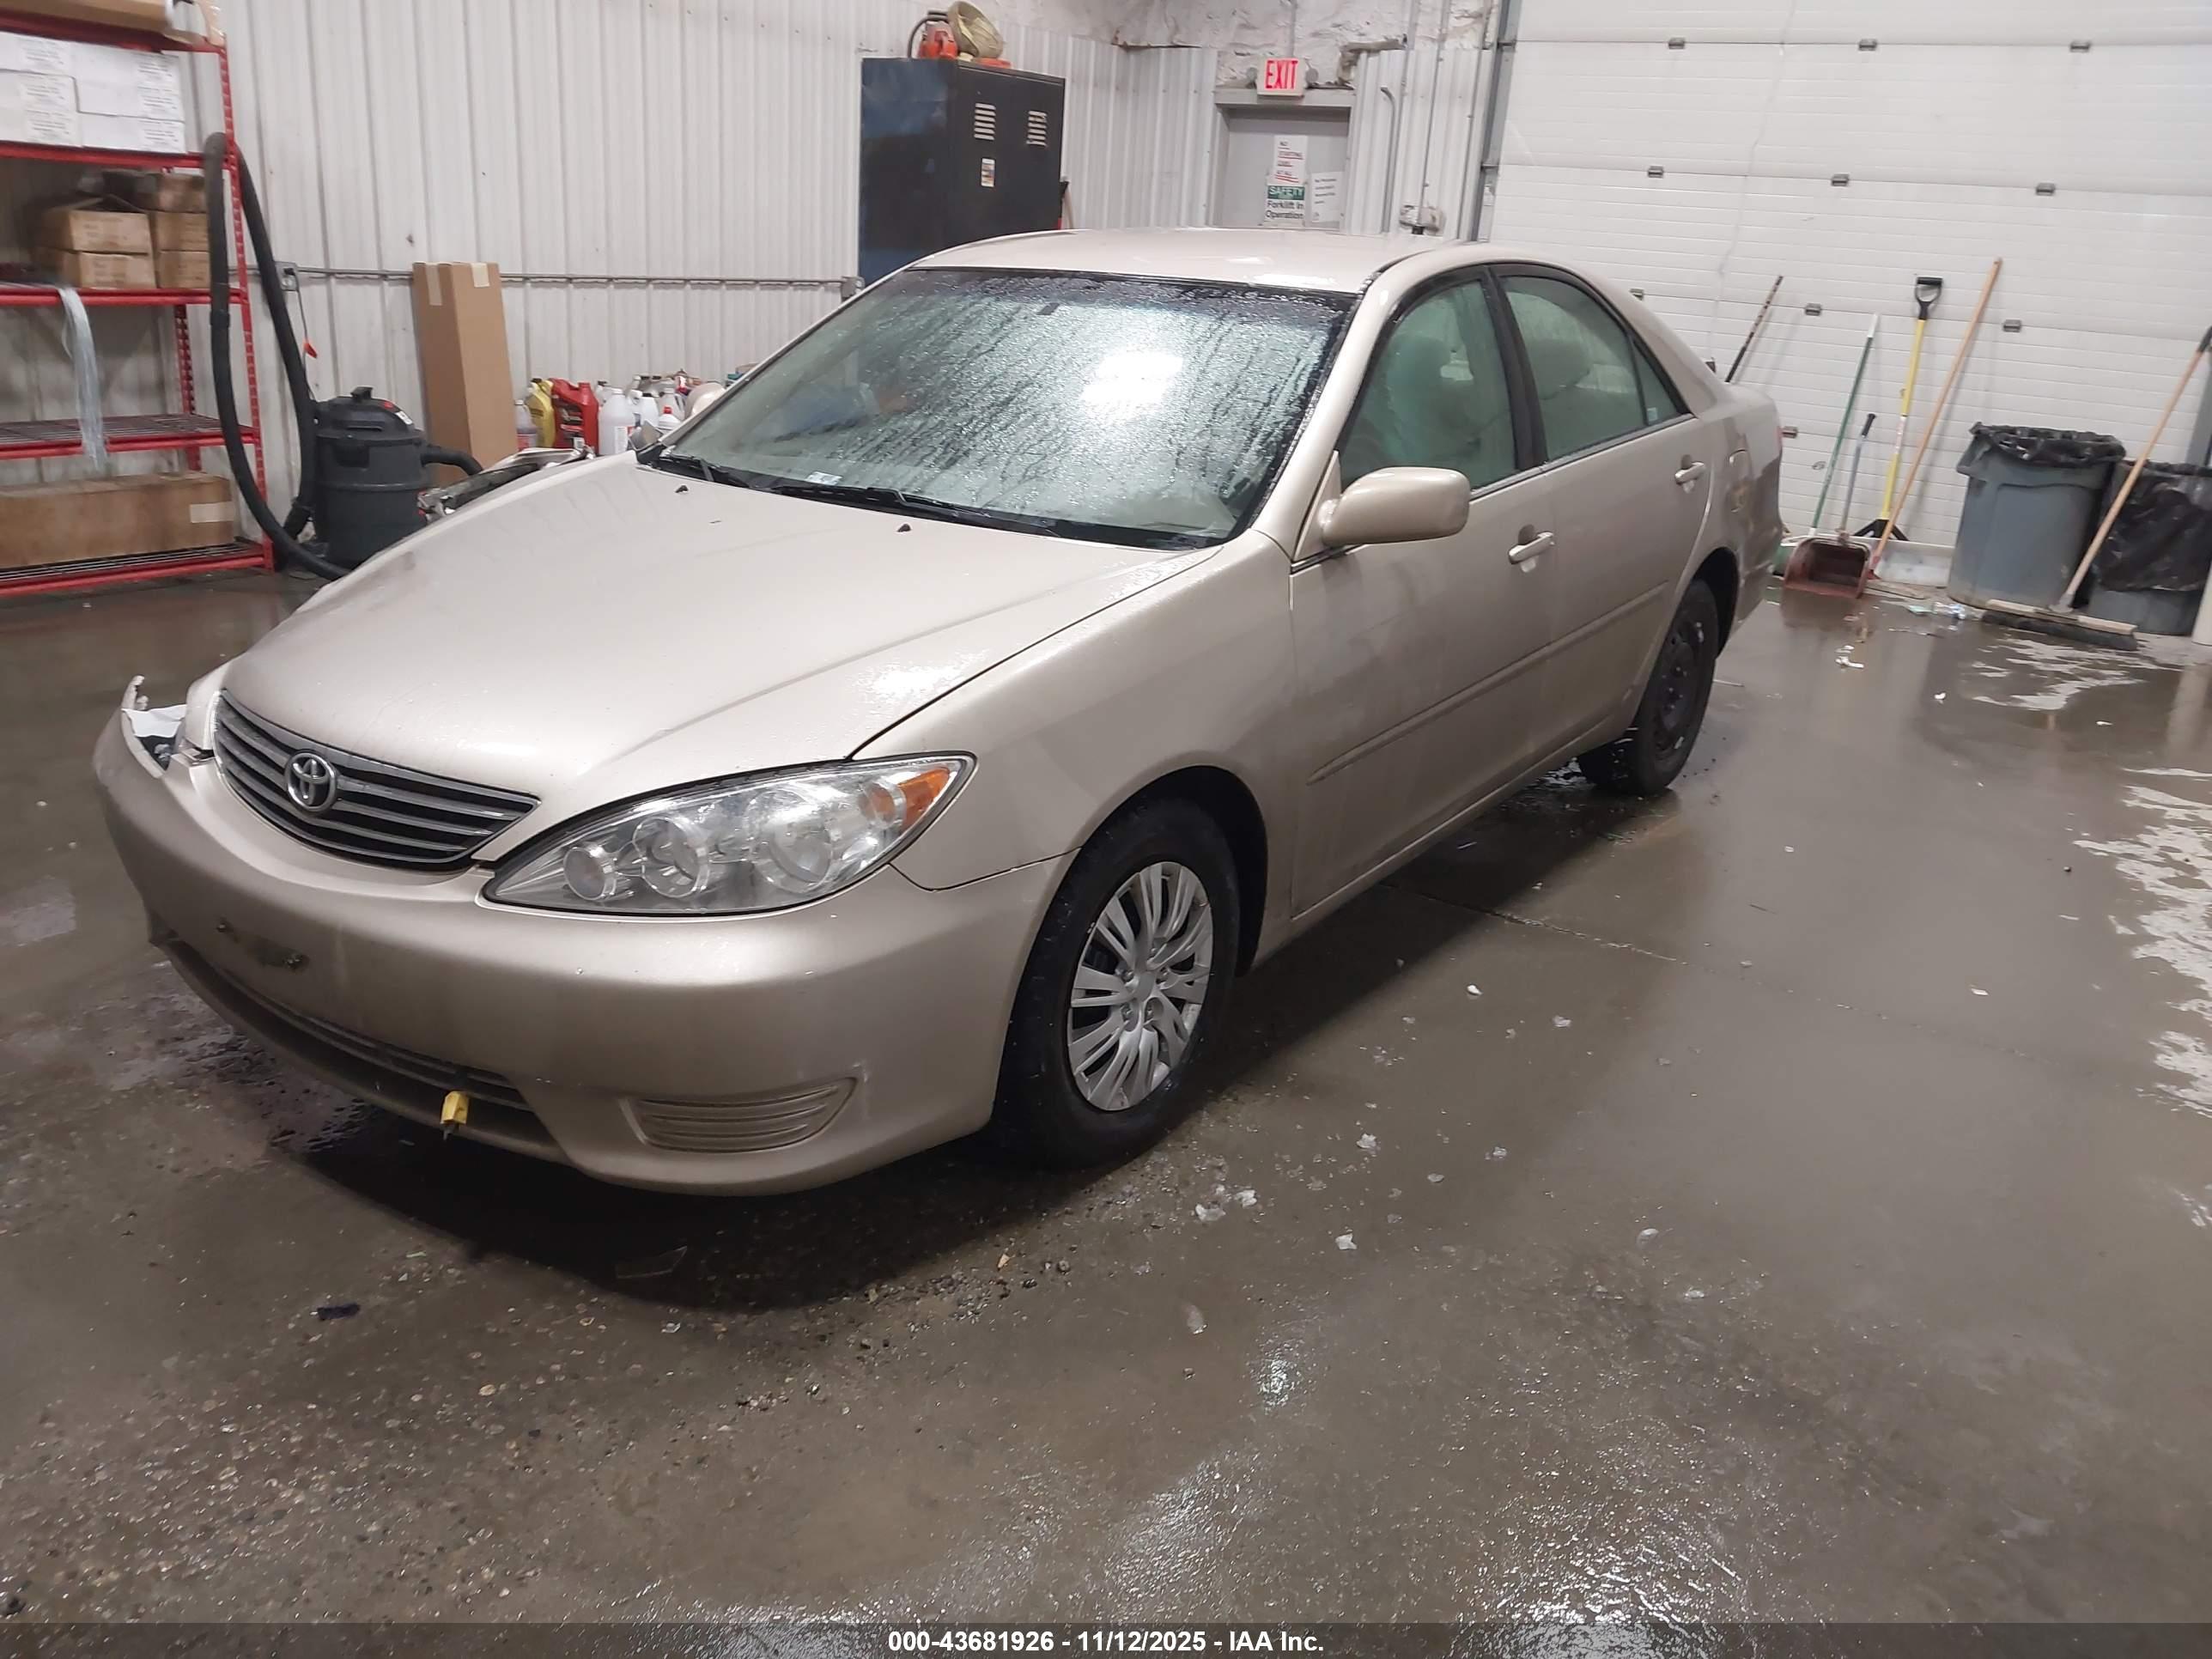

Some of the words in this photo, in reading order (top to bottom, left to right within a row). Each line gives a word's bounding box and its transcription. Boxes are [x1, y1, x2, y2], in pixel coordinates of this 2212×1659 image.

[1266, 60, 1298, 89] EXIT
[1269, 185, 1304, 197] SAFETY
[1267, 200, 1295, 209] Forklift
[1266, 210, 1304, 219] Operation
